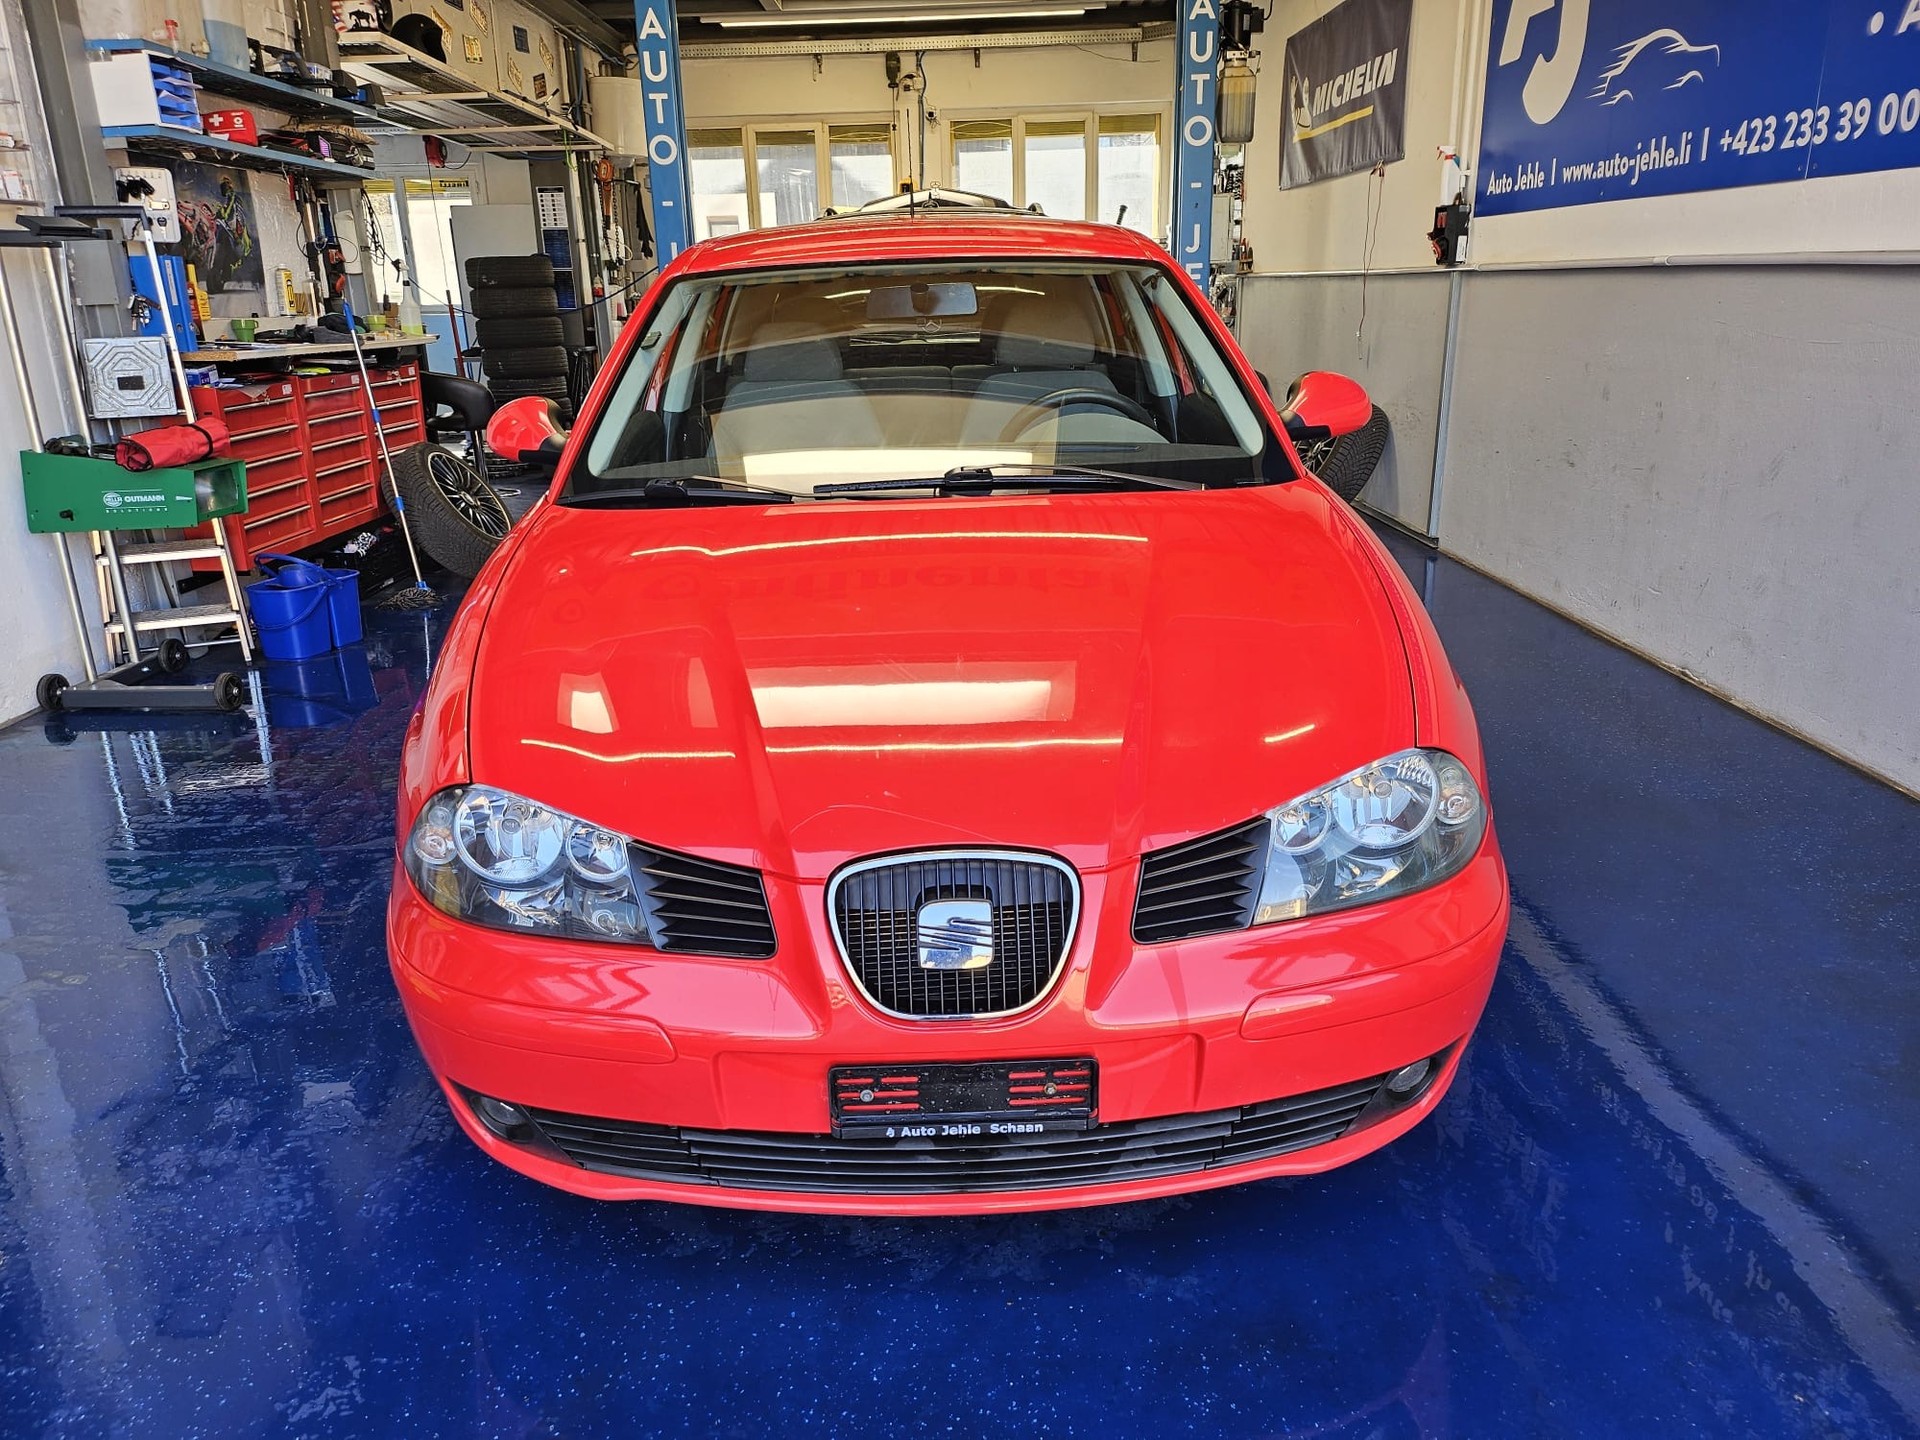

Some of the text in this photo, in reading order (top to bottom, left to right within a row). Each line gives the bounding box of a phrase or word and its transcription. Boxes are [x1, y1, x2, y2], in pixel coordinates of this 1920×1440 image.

[639, 7, 678, 165] AUTO
[1312, 48, 1398, 117] MICHELIN
[1487, 170, 1513, 196] Auto
[1514, 161, 1545, 192] Jehle
[1563, 131, 1693, 186] www.auto-jehle.li
[1720, 115, 1778, 156] +423
[1780, 105, 1831, 150] 233
[1834, 97, 1872, 142] 39
[1879, 88, 1920, 136] 00
[901, 1126, 936, 1137] Auto
[942, 1123, 982, 1136] Jehle
[990, 1122, 1044, 1134] Schaan
